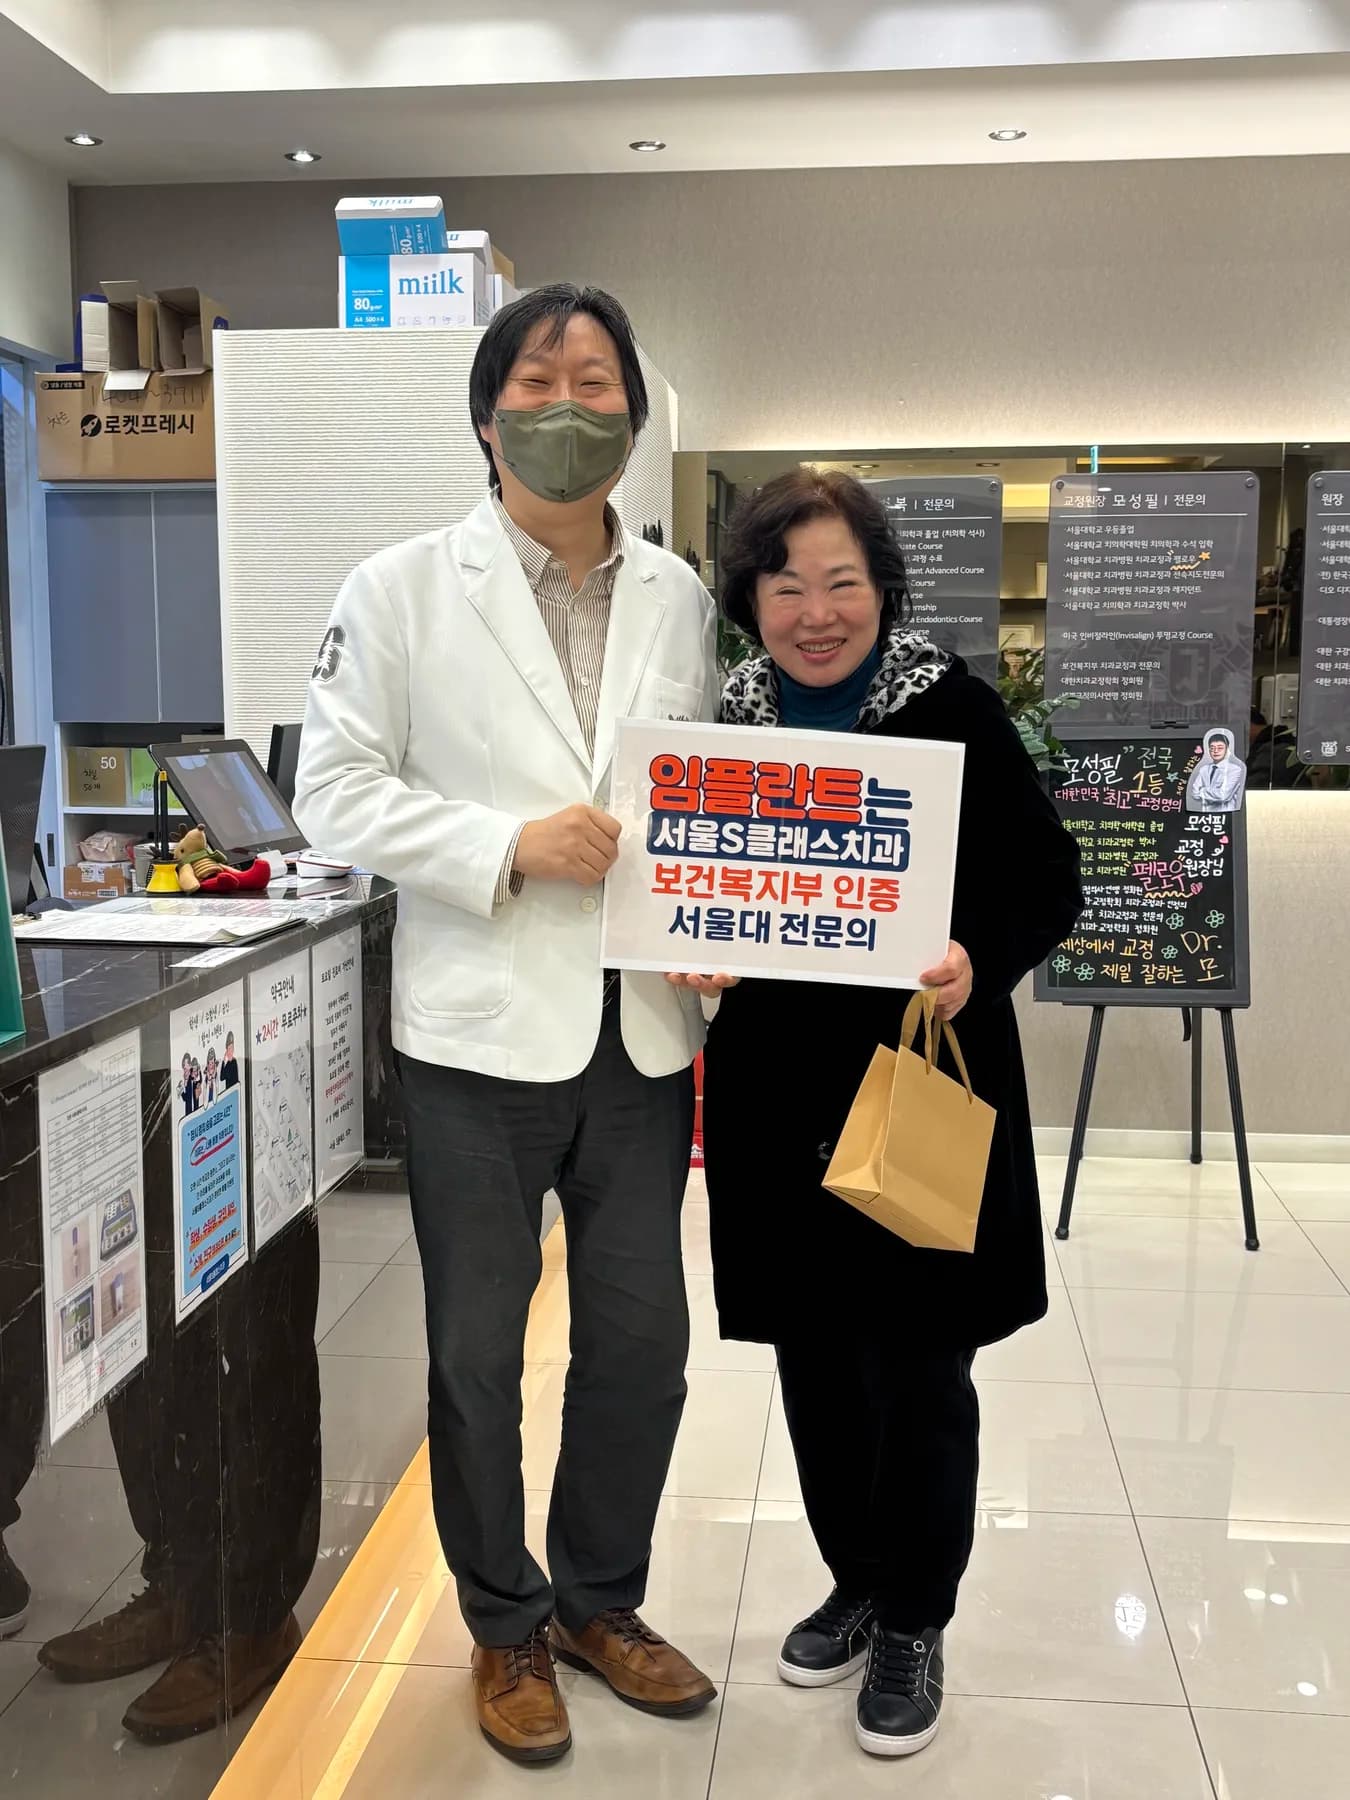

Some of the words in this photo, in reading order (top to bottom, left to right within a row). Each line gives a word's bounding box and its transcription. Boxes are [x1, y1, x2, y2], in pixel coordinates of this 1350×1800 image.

[398, 268, 465, 295] miilk
[353, 297, 370, 310] 80
[104, 414, 194, 435] 로켓프레시
[923, 498, 955, 511] 전문의
[1063, 495, 1106, 508] 교정원장
[1173, 493, 1206, 508] 전문의
[1321, 493, 1344, 506] 원장
[1066, 525, 1103, 535] 서울대학교
[918, 542, 944, 550] Course
[1066, 540, 1102, 551] 서울대학교
[1150, 540, 1180, 549] 치의학과
[1181, 540, 1197, 548] 수석
[1198, 539, 1214, 549] 입학
[1065, 555, 1102, 565] 서울대학교
[1104, 555, 1133, 565] 치과병원
[1135, 554, 1172, 565] 치과교정과
[905, 567, 923, 575] plant
[925, 567, 959, 575] Advanced
[959, 566, 985, 574] Course
[1065, 570, 1101, 581] 서울대학교
[1103, 570, 1133, 580] 치과병원
[1135, 570, 1171, 580] 치과교정과
[1333, 570, 1350, 580] 한국
[911, 579, 936, 587] Course
[1065, 585, 1101, 596] 서울대학교
[1102, 585, 1132, 595] 치과병원
[1134, 585, 1171, 595] 치과교정과
[1064, 601, 1100, 611] 서울대학교
[1102, 601, 1132, 610] 치의학과
[1133, 600, 1170, 610] 치과교정학
[1171, 600, 1187, 610] 박사
[916, 615, 958, 623] Endodontics
[958, 615, 983, 623] Course
[1063, 631, 1077, 641] 미국
[1187, 631, 1214, 640] Course
[1061, 661, 1098, 672] 보건복지부
[1100, 661, 1137, 671] 치과교정과
[1138, 661, 1161, 671] 전문의
[1061, 676, 1119, 686] 대한치과교정학회
[1121, 676, 1144, 686] 정회원
[1120, 691, 1143, 701] 정회원
[100, 756, 117, 770] 50
[1129, 771, 1165, 796] 1등
[649, 753, 913, 828] 임플란트는
[1054, 787, 1100, 803] 대한민국
[1136, 796, 1183, 813] 교정명의
[1183, 814, 1226, 835] 모성필
[652, 817, 905, 867] 서울S클래스치과
[1139, 836, 1157, 847] 박사
[1174, 839, 1204, 857] 교정
[1097, 851, 1128, 863] 치과병원
[1132, 851, 1159, 862] 교정과
[1096, 866, 1128, 877] 치과병원
[1183, 858, 1224, 879] 원장님
[650, 862, 823, 908] 보건복지부
[833, 875, 901, 913] 인증
[1142, 910, 1164, 923] 전문의
[668, 905, 771, 945] 서울대
[777, 912, 877, 952] 전문의
[1057, 936, 1115, 956] 세상에서
[1120, 938, 1154, 960] 교정
[1180, 930, 1223, 955] Dr.
[1100, 962, 1132, 983] 제일
[1139, 963, 1187, 985] 잘하는
[1197, 957, 1225, 983] 모
[270, 974, 295, 1003] 약국안내
[261, 1017, 279, 1042] 2시간
